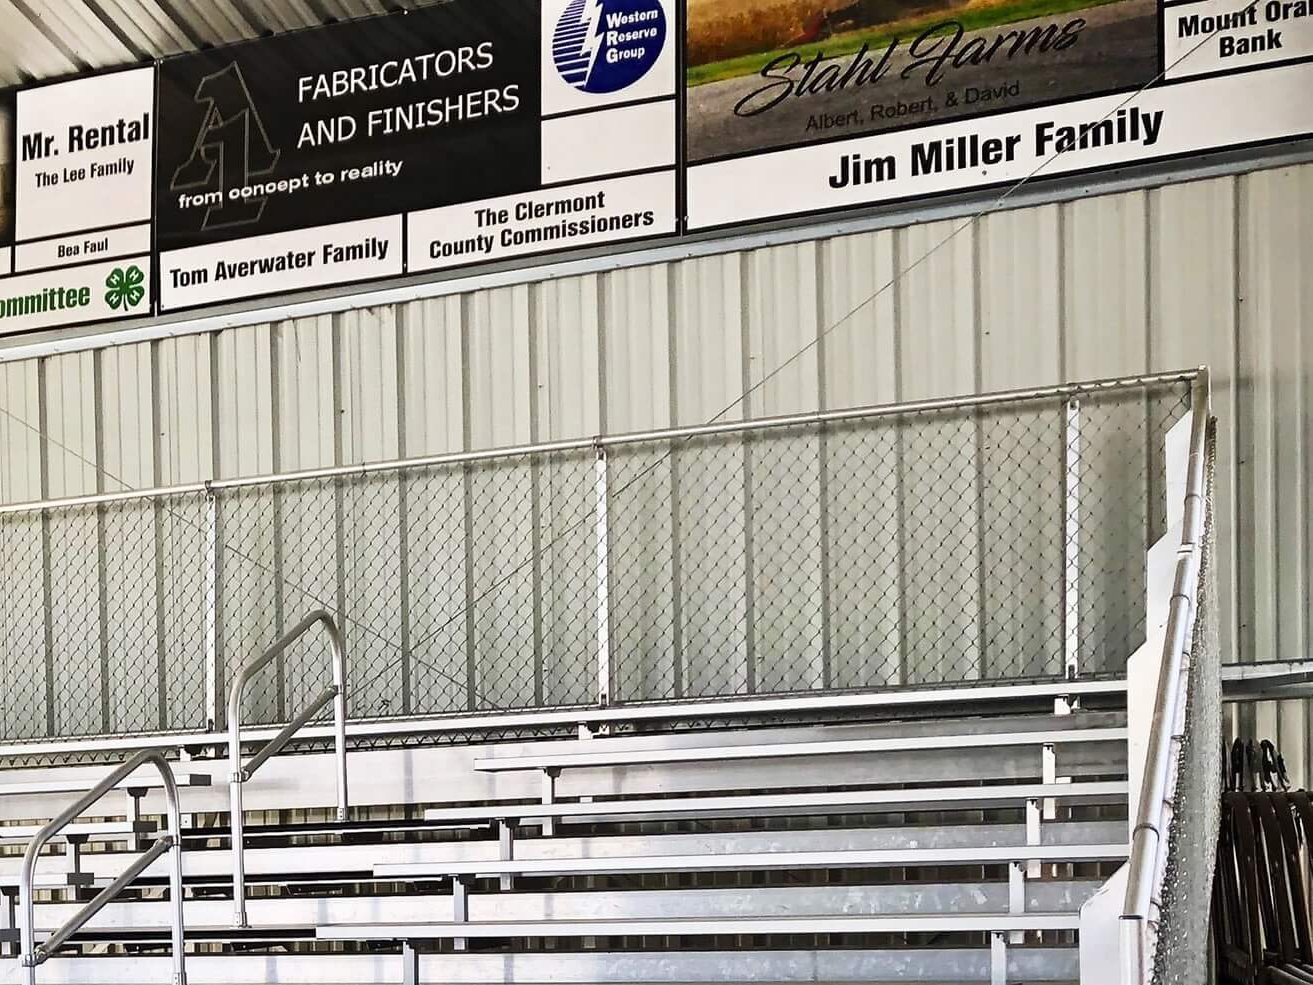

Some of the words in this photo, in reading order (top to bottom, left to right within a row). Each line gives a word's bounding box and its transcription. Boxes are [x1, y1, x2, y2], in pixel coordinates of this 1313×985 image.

[606, 9, 658, 29] Western
[606, 27, 658, 46] Reserve
[1178, 5, 1257, 38] Mount
[1219, 28, 1283, 58] Bank
[297, 42, 495, 103] FABRICATORS
[606, 47, 646, 63] Group
[733, 38, 900, 118] Stahl
[901, 17, 1087, 87] Farms
[297, 114, 357, 149] AND
[367, 84, 520, 137] FINISHERS
[805, 108, 864, 132] Albert,
[870, 97, 938, 121] Robert,
[945, 92, 958, 108] &
[965, 80, 1021, 104] David
[22, 131, 59, 162] Mr.
[68, 111, 149, 153] Rental
[829, 151, 896, 189] Jim
[911, 131, 1022, 177] Miller
[1035, 106, 1164, 157] Family
[35, 171, 59, 188] The
[63, 167, 86, 183] Lee
[90, 157, 134, 178] Family
[178, 190, 223, 209] from
[228, 173, 310, 201] concept
[314, 170, 335, 185] to
[340, 158, 404, 182] reality
[474, 207, 509, 228] The
[514, 190, 606, 221] Clermont
[57, 244, 80, 258] Bea
[84, 237, 109, 254] Faul
[429, 232, 494, 260] County
[500, 210, 655, 248] Commissioners
[170, 266, 209, 289] Tom
[214, 248, 316, 282] Averwater
[322, 237, 389, 265] Family
